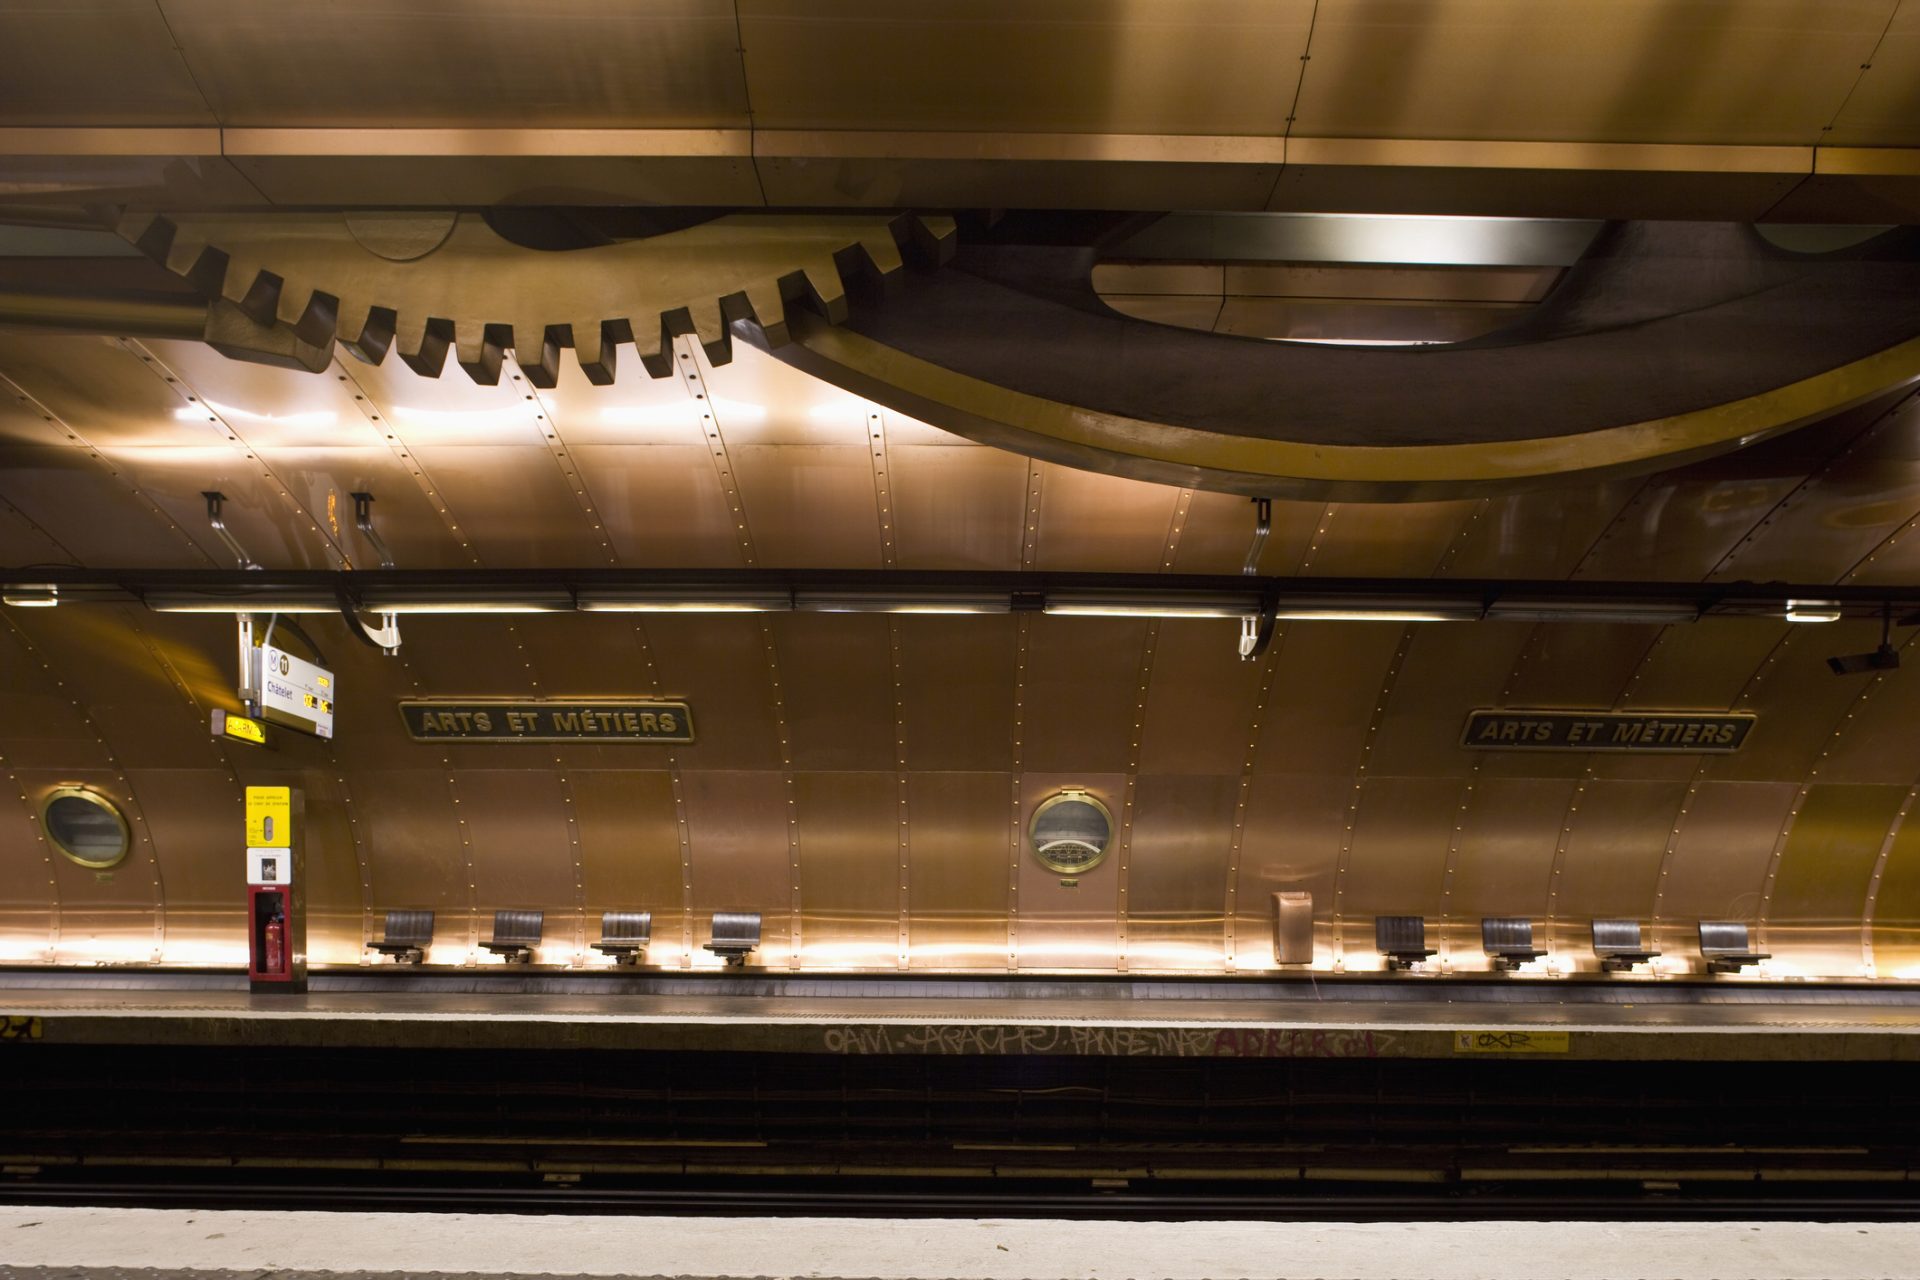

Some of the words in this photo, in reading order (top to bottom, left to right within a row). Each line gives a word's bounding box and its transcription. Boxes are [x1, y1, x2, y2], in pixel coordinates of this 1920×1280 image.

[281, 658, 288, 673] 11
[267, 680, 294, 700] Châtelet
[422, 711, 492, 733] ARTS
[507, 711, 538, 733] ET
[552, 709, 677, 734] MÉTIERS
[1479, 720, 1554, 741] ARTS
[1567, 722, 1604, 742] ET
[1612, 719, 1737, 744] MÉTIERS
